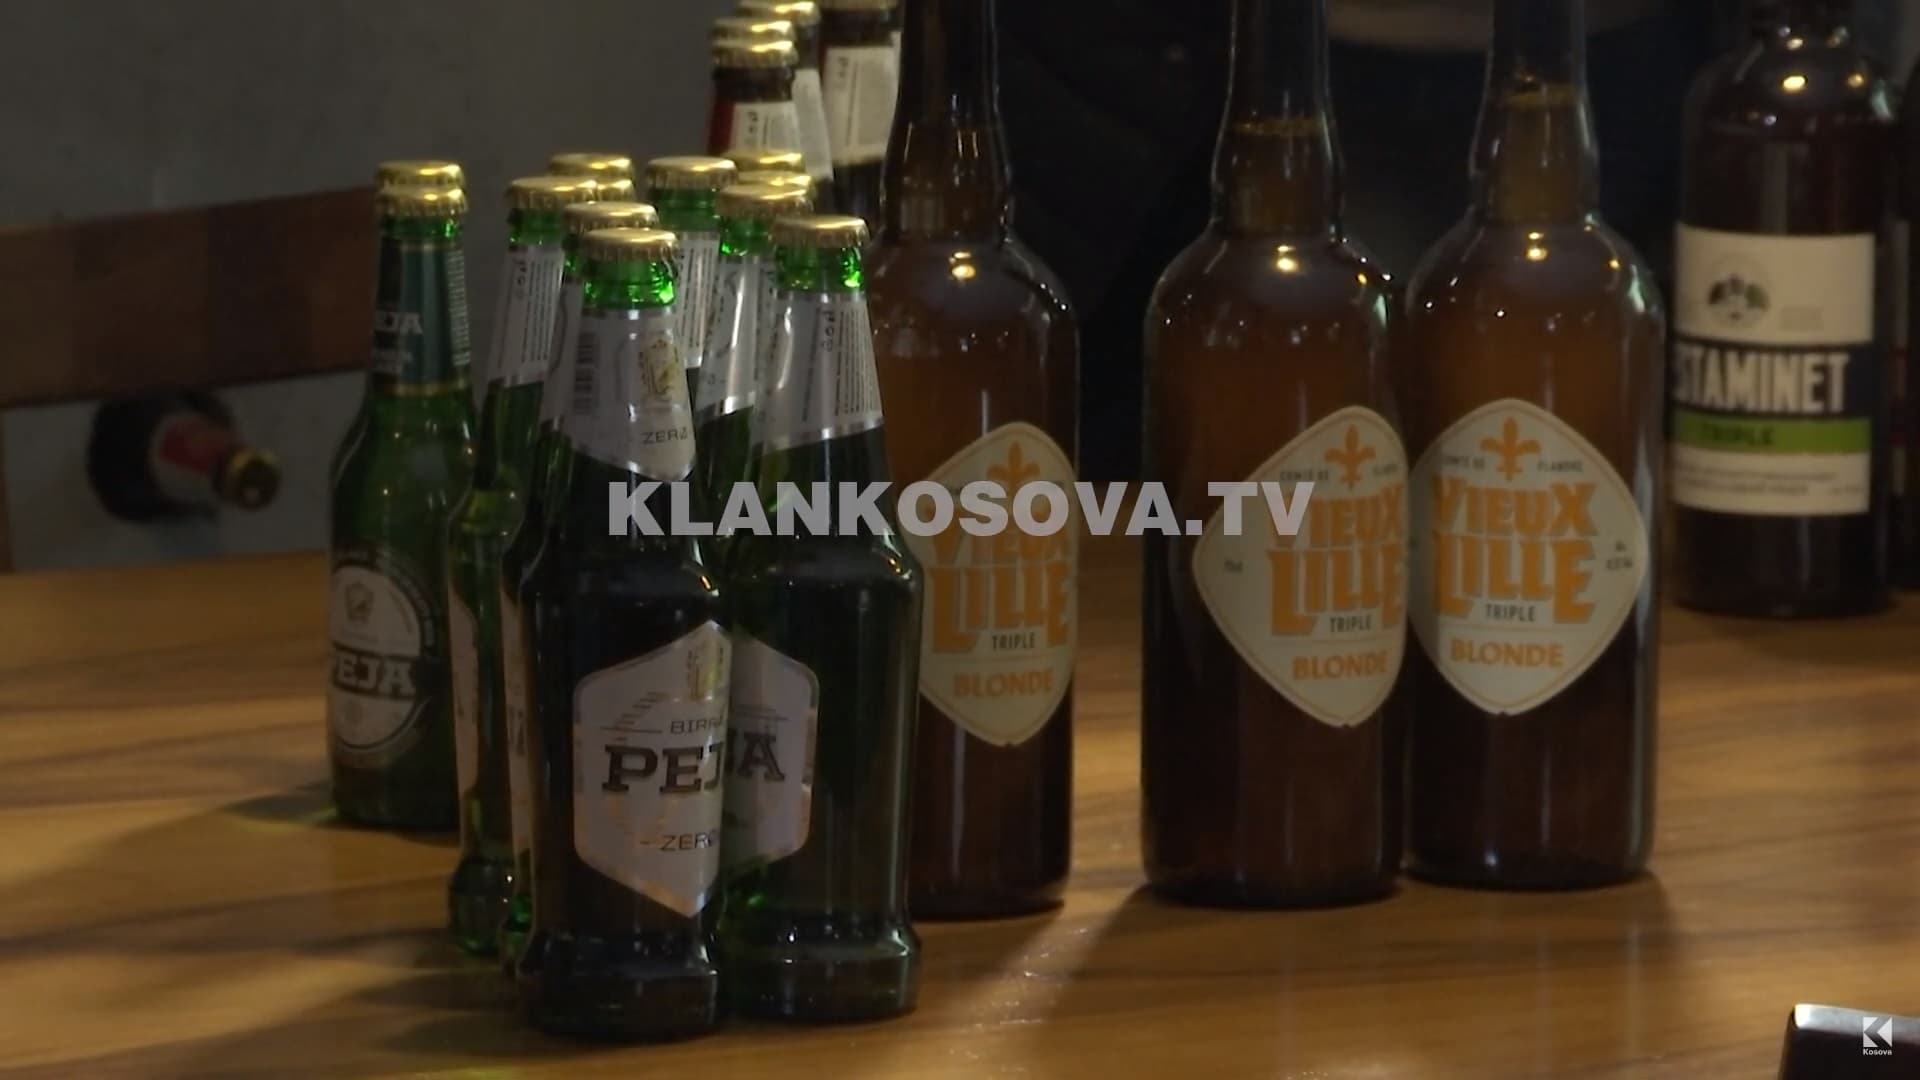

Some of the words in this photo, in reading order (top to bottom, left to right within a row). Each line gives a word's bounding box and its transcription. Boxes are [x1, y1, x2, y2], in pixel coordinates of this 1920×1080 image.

[1674, 342, 1850, 413] STAMINET
[1268, 487, 1404, 547] IEUX
[1267, 543, 1404, 637] LILLE
[1433, 532, 1595, 624] LILLE
[929, 561, 1068, 652] LILLE
[1329, 614, 1373, 633] TRIPLE
[1484, 602, 1537, 622] TRIPLE
[992, 631, 1037, 650] TRIPLE
[1451, 639, 1564, 666] BLONDE
[337, 653, 417, 696] EJA
[953, 670, 1055, 696] BLONDE
[1292, 652, 1388, 679] BLONDE
[602, 741, 724, 793] PEJ
